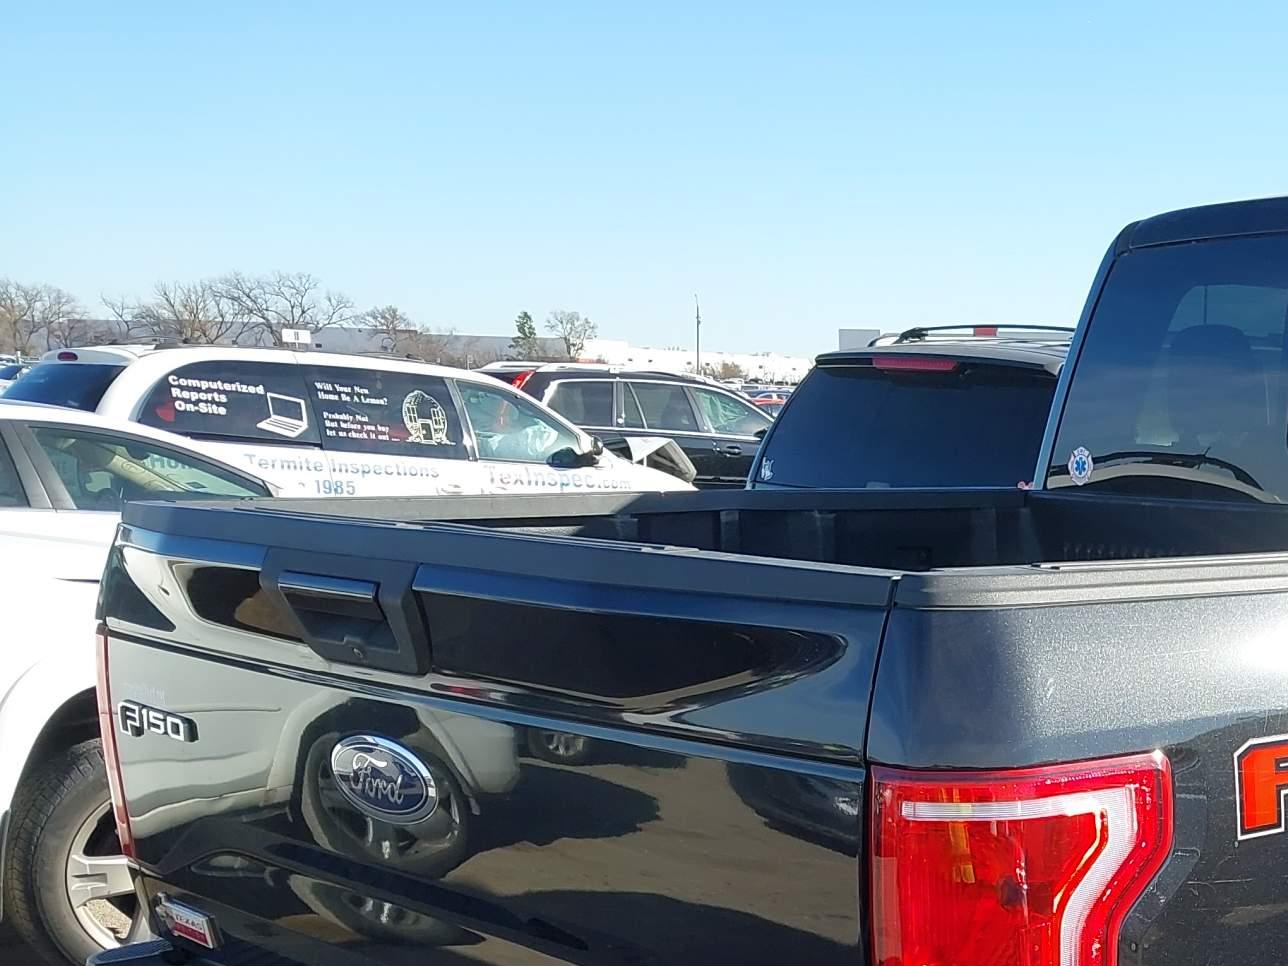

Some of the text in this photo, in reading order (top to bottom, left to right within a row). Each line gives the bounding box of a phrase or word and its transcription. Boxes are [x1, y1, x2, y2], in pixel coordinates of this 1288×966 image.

[168, 375, 265, 395] Computerized
[314, 381, 370, 395] Will Your New
[171, 387, 228, 403] Reports
[317, 391, 388, 406] Home Be A Lemon?
[174, 400, 227, 415] On-Site
[322, 411, 353, 422] Probably
[324, 419, 338, 428] But
[340, 421, 361, 430] before
[376, 424, 389, 433] buy
[326, 428, 336, 437] let
[348, 430, 368, 439] check
[243, 453, 440, 478] Termite Inspections
[315, 480, 356, 496] 1985
